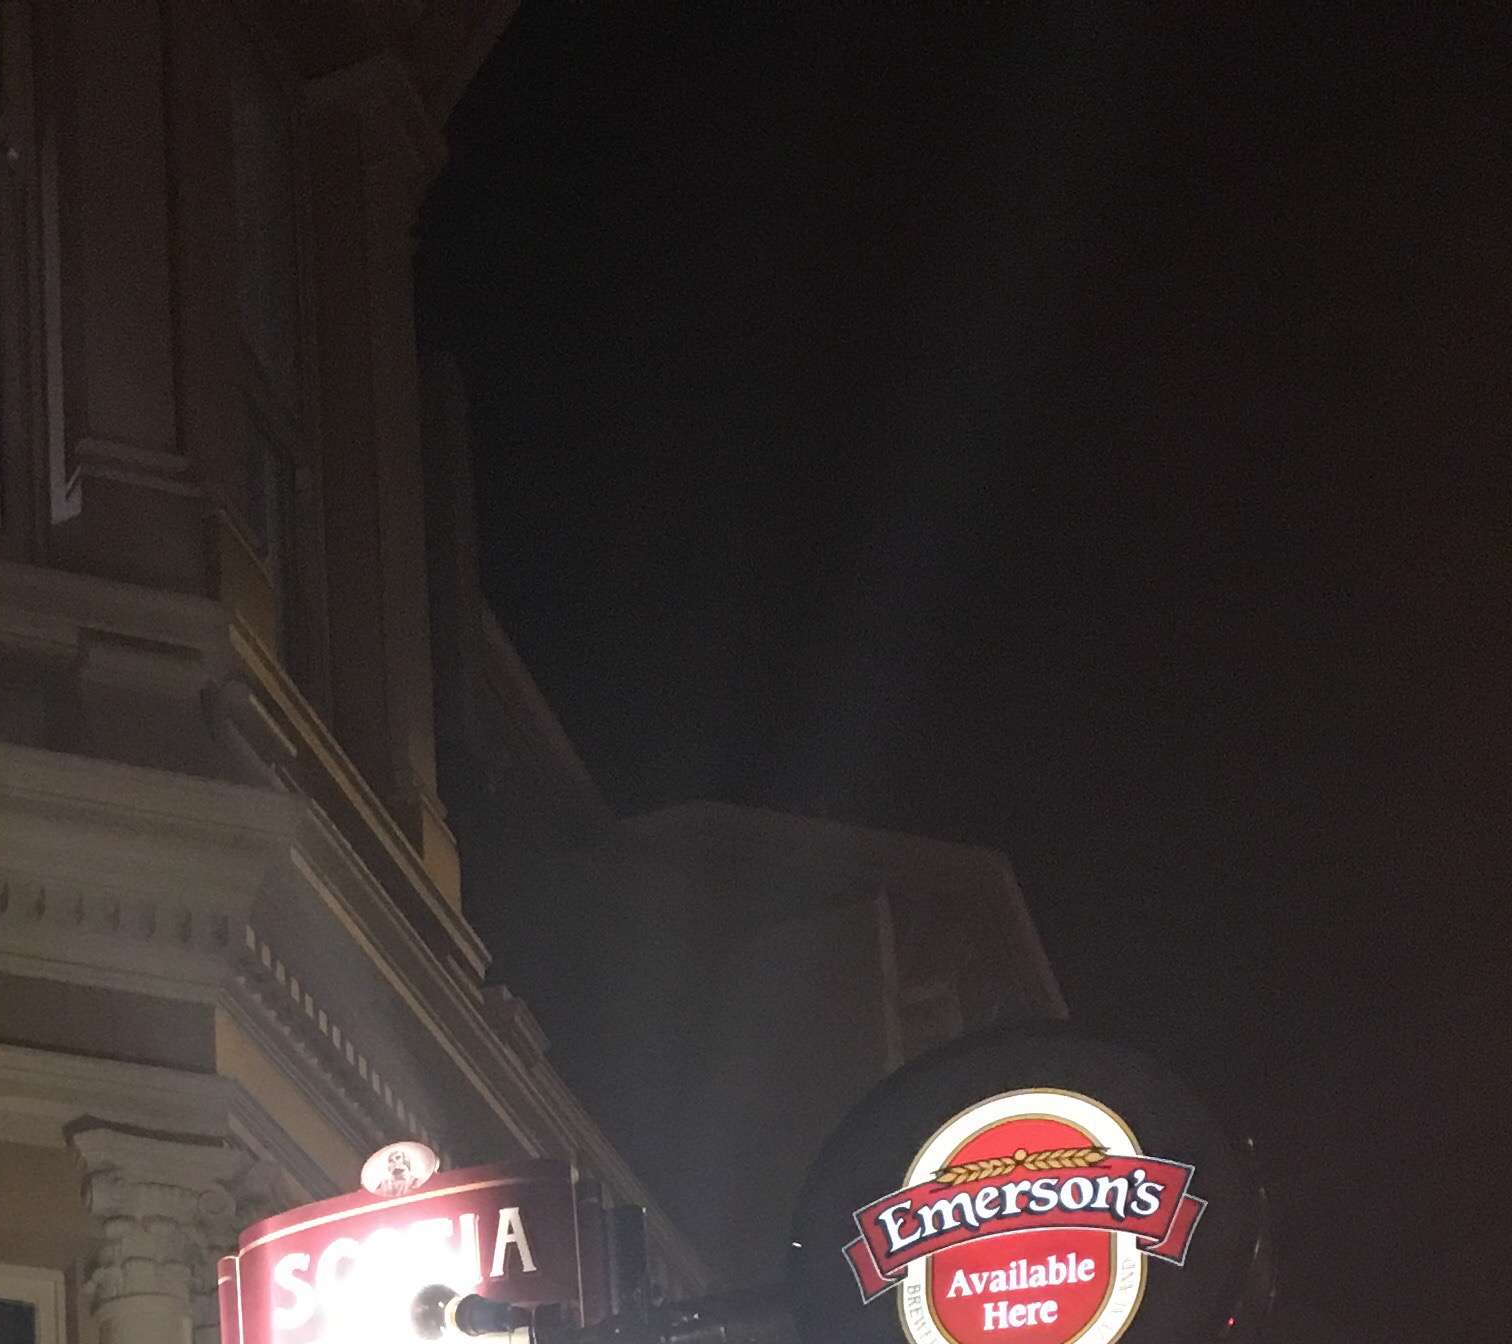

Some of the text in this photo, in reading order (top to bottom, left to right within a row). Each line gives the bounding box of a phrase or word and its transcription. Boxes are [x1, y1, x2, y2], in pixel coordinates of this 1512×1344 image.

[877, 1167, 1166, 1254] Emerson's
[273, 1206, 537, 1330] SCTIA
[945, 1251, 1096, 1300] Available
[982, 1297, 1059, 1332] Here
